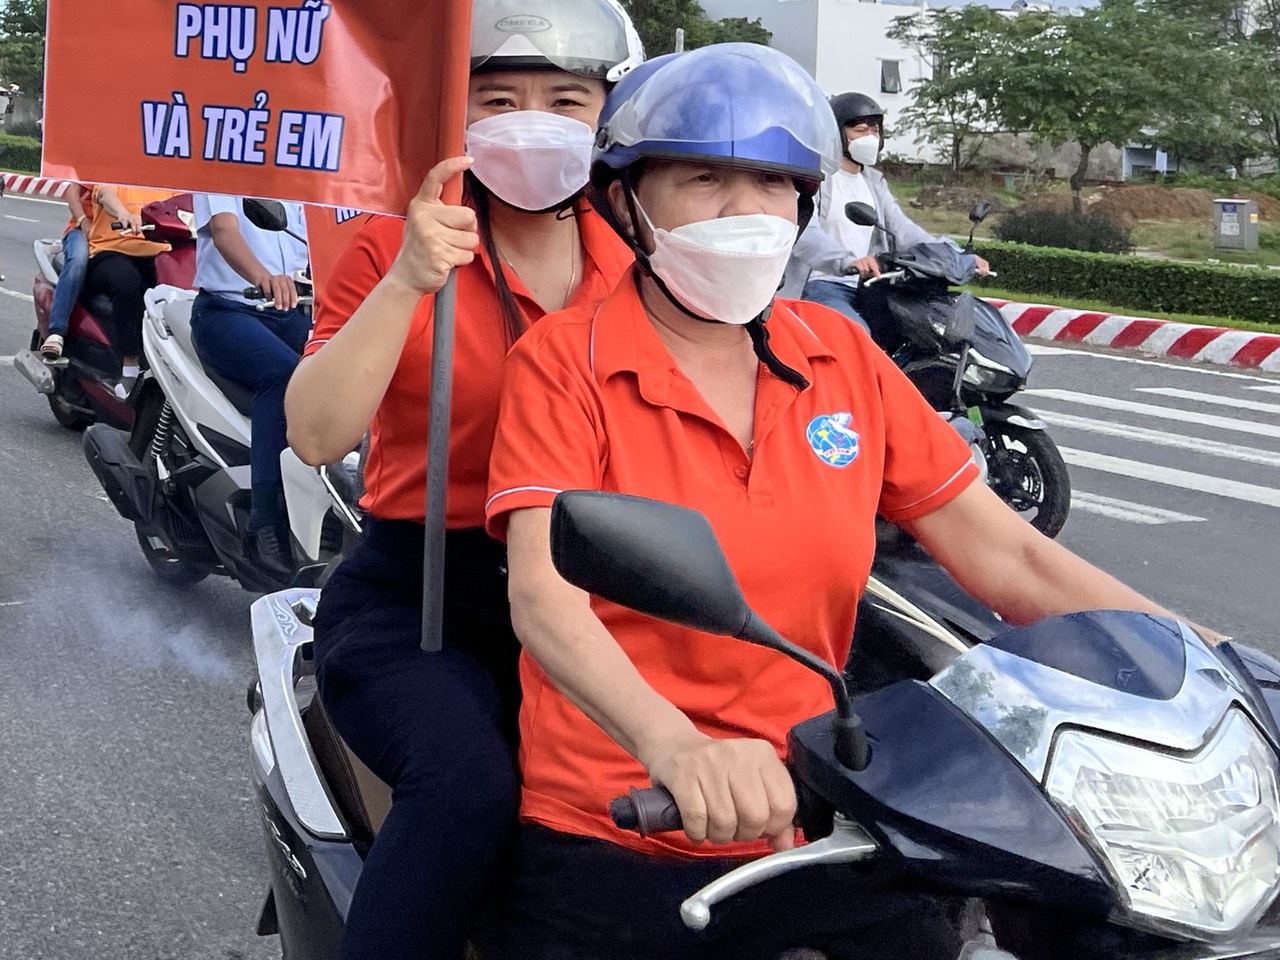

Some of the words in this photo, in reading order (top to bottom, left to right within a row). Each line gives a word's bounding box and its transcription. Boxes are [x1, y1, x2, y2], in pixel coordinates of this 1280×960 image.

[174, 2, 256, 72] PHỤ
[499, 19, 547, 28] OMEGA
[141, 90, 191, 159] VÀ
[202, 90, 268, 164] TRẺ
[275, 110, 344, 172] EM
